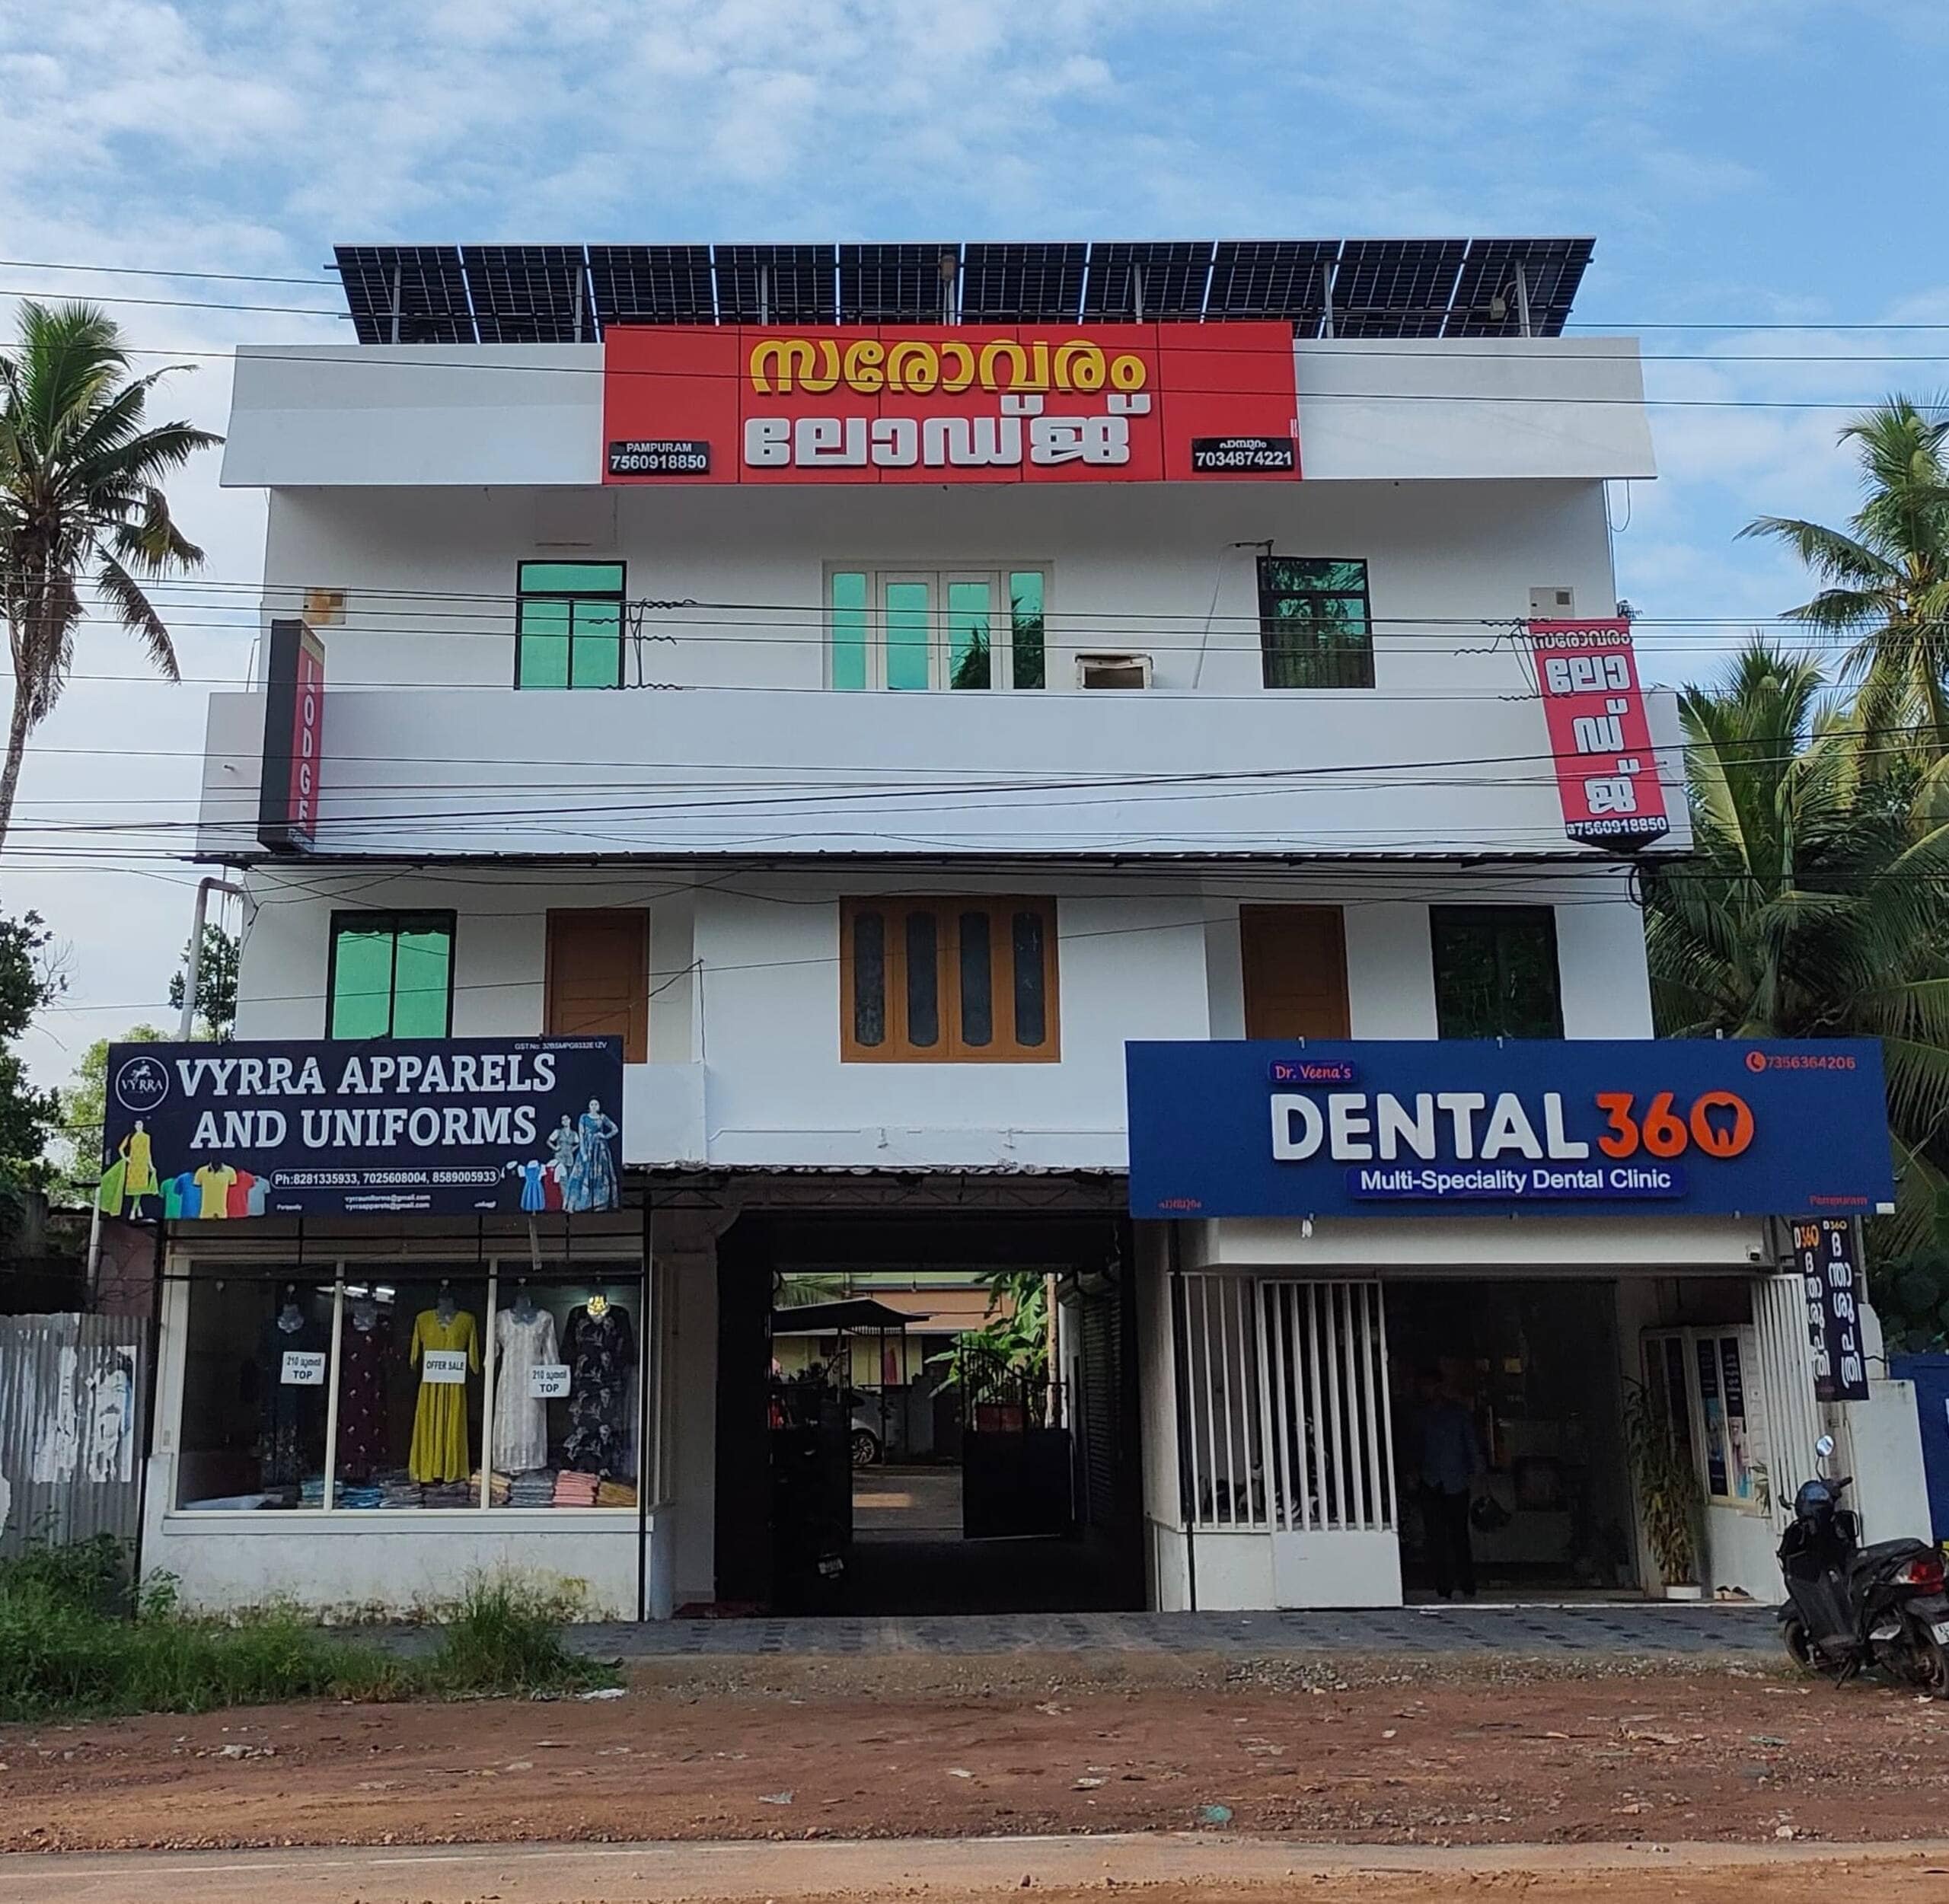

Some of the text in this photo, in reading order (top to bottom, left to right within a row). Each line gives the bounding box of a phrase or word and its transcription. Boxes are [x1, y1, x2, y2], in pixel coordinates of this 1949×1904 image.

[749, 340, 1147, 394] സരോവരം
[745, 394, 1151, 466] ലോഡ്ജ്
[626, 443, 692, 452] PAMPURAM
[611, 454, 707, 469] 7560918850
[1195, 451, 1292, 467] 7034874221
[1574, 817, 1667, 836] 7560918850
[176, 1054, 556, 1097] VYRRA APPARELS
[1275, 1064, 1352, 1080] Dr. Veena's
[121, 1078, 163, 1092] VYRRA
[190, 1105, 536, 1149] AND UNIFORMS
[1270, 1091, 1755, 1160] DENTAL 360
[432, 1171, 496, 1182] 8589005933
[1360, 1169, 1672, 1194] Multi-Speciality Dental Clinic
[1823, 1220, 1848, 1230] D360
[426, 1360, 464, 1371] OFFER SALE
[292, 1370, 313, 1379] TOP
[539, 1383, 560, 1393] TOP
